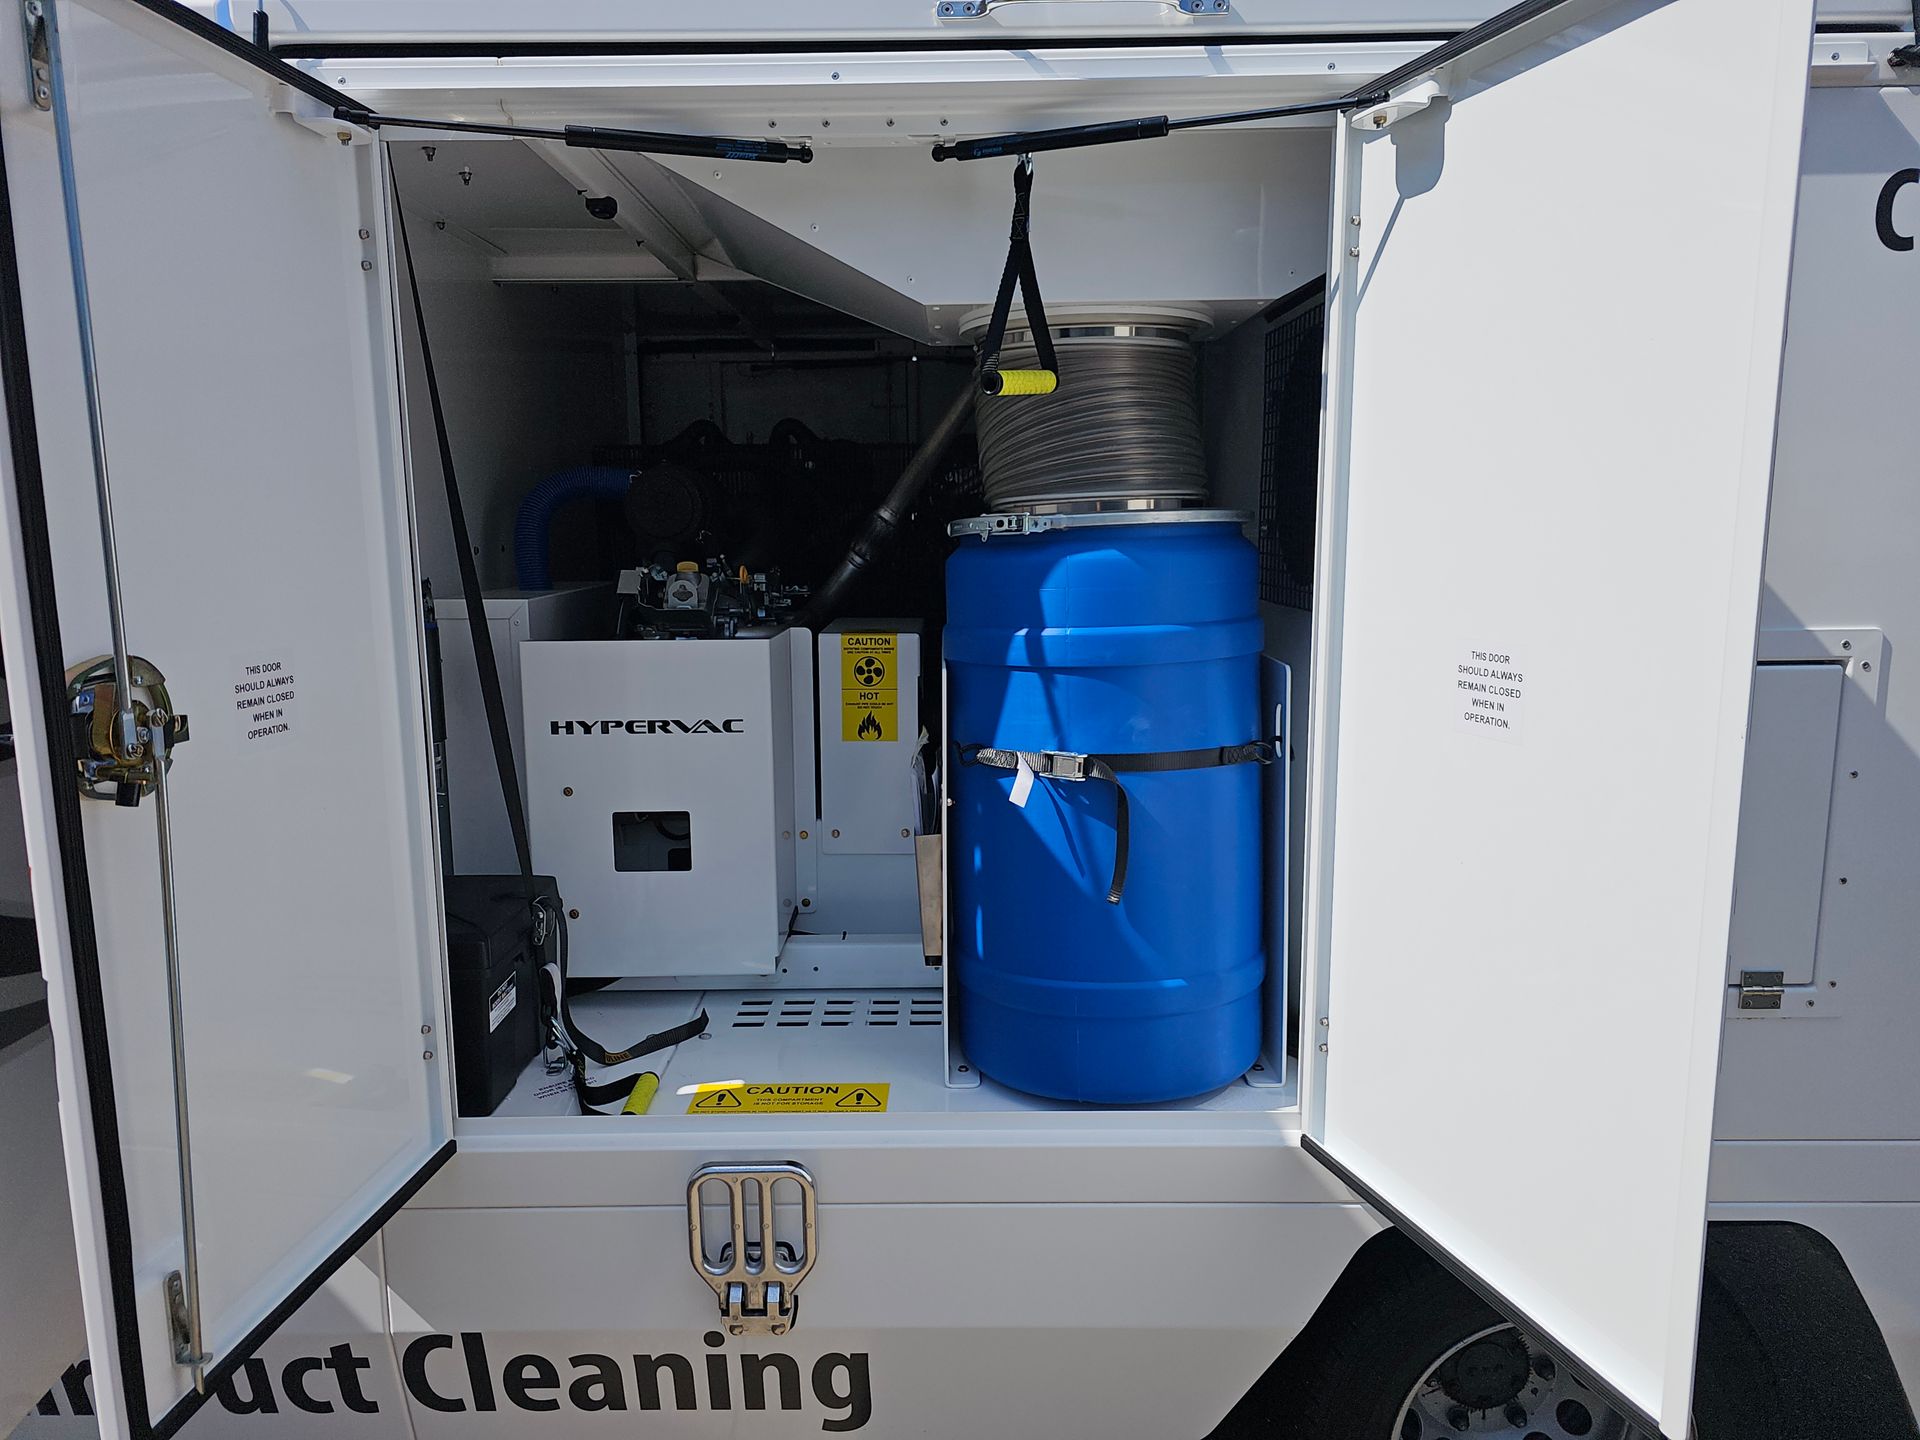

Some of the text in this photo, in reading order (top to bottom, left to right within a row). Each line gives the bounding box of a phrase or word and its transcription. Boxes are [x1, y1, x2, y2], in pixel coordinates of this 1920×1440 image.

[847, 637, 891, 646] CAUTION
[1471, 651, 1511, 664] THIS DOOR
[245, 662, 282, 675] THIS DOOR
[1458, 664, 1523, 683] SHOULD ALWAYS
[234, 675, 295, 694] SHOULD ALWAYS
[1458, 680, 1522, 698] REMAIN CLOSED
[236, 690, 295, 709] REMAIN CLOSED
[859, 692, 880, 700] HOT
[1471, 697, 1505, 712] WHEN IN
[252, 708, 283, 722] WHEN IN
[1464, 712, 1511, 730] OPERATION.
[247, 722, 291, 740] OPERATION.
[550, 719, 745, 735] HYPERVAC
[746, 1086, 840, 1095] CAUTION
[402, 1330, 874, 1433] Cleaning
